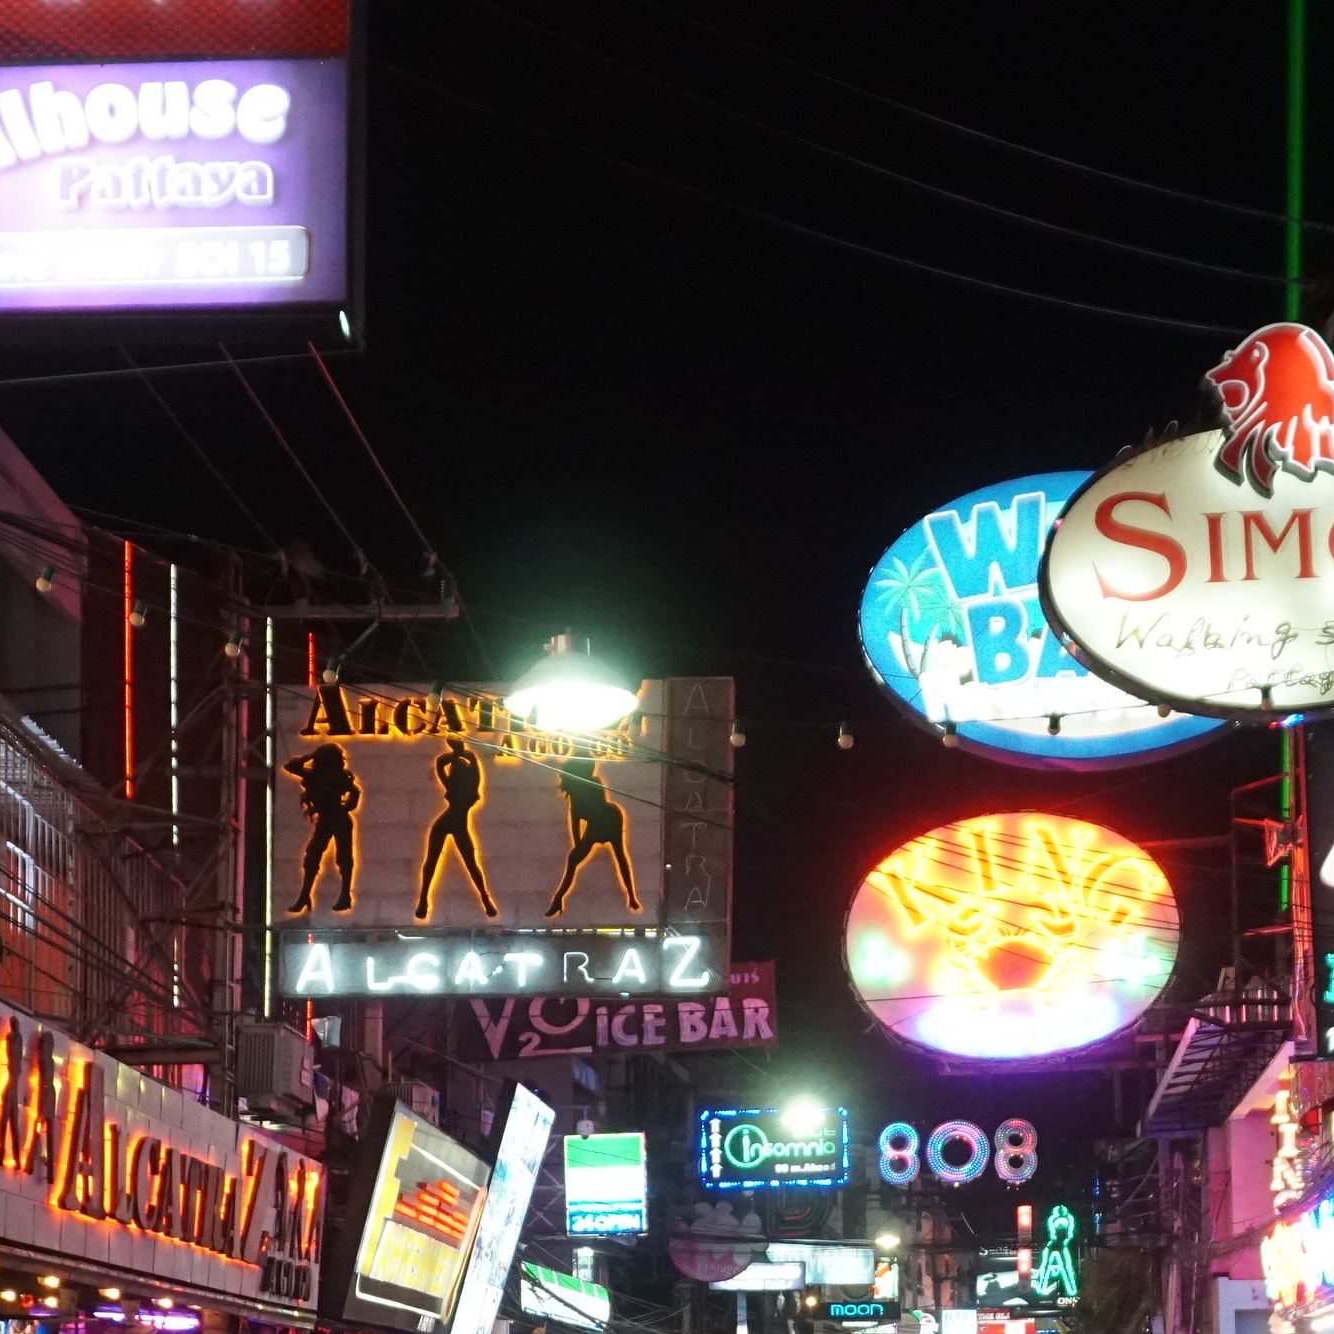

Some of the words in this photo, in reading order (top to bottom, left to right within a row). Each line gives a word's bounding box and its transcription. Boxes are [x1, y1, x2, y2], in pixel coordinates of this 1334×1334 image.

[54, 156, 276, 211] Pattaya
[174, 240, 239, 278] SOI
[248, 239, 293, 275] 15
[296, 936, 712, 994] ALCATRAZ
[595, 1003, 668, 1047] ICE
[679, 996, 775, 1045] BAR
[47, 1058, 270, 1266] ALCATRAZ
[878, 1117, 1039, 1186] 808
[830, 1303, 884, 1316] moon
